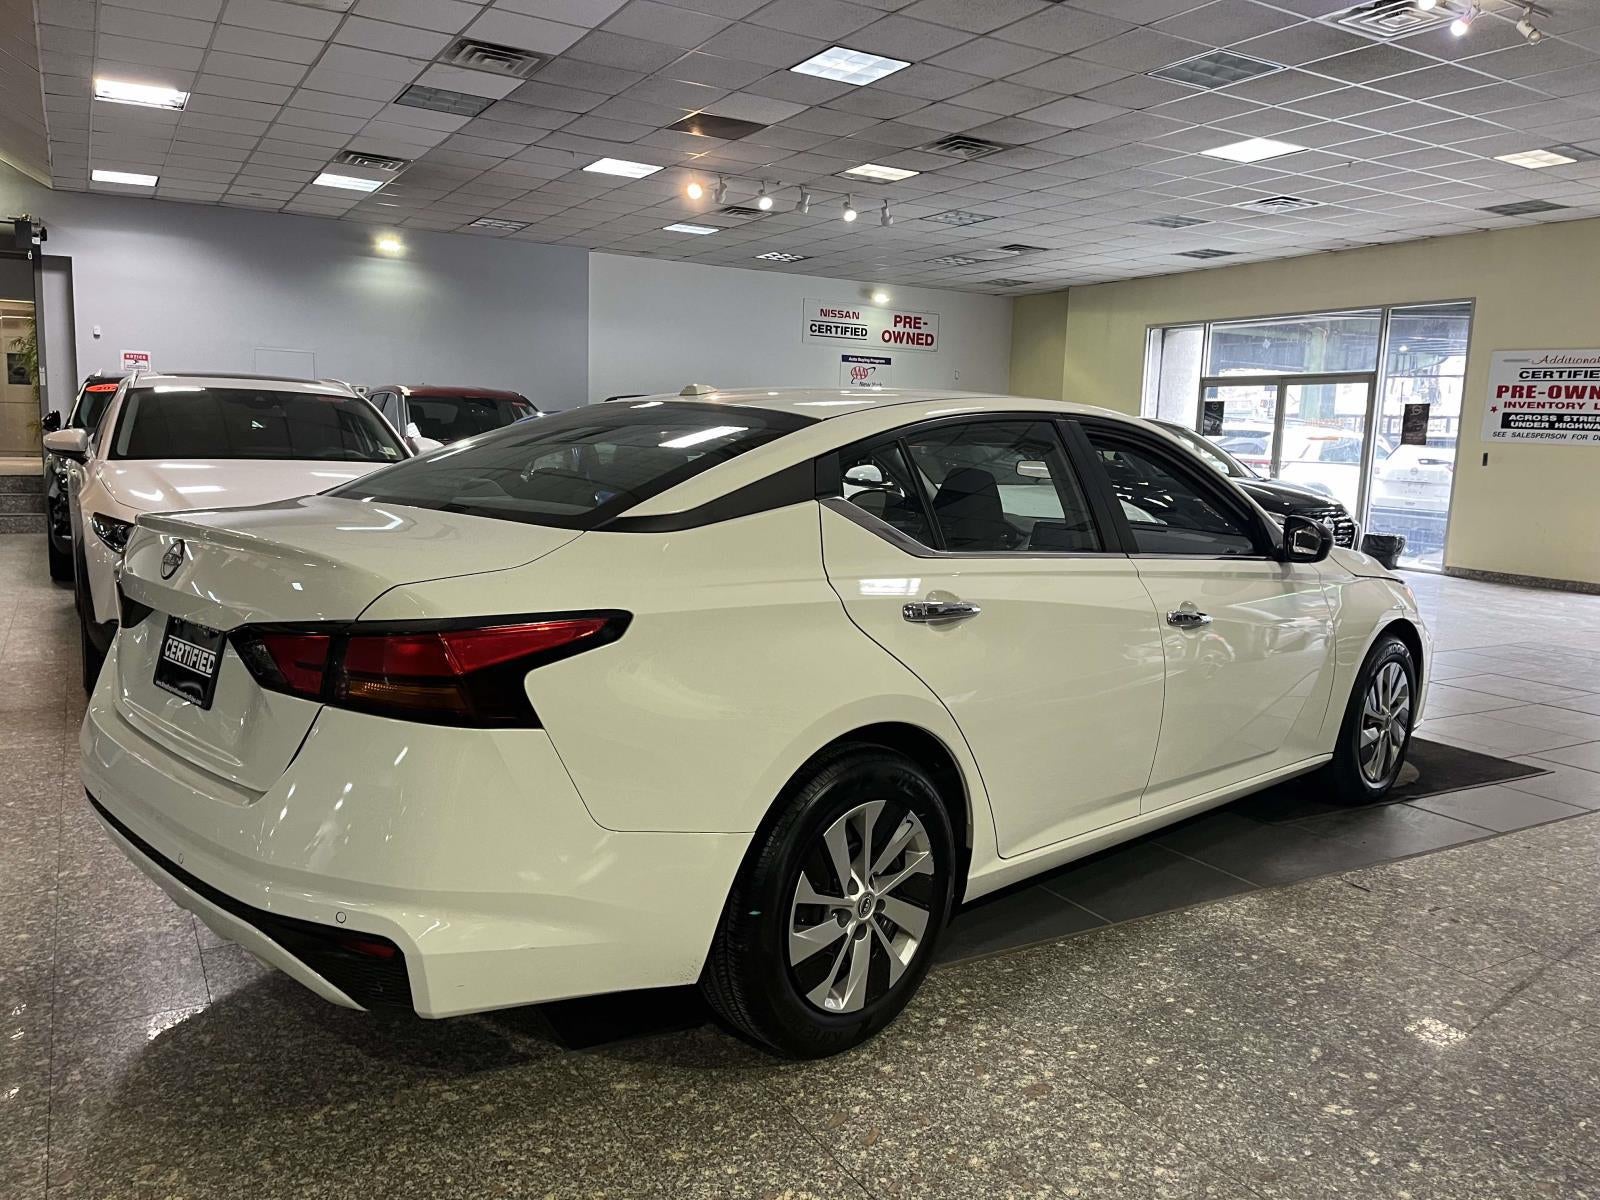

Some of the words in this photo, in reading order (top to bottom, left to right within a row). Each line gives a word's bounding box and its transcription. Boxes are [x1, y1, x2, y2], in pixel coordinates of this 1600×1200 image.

[820, 308, 860, 320] NISSAN
[893, 314, 928, 330] PRE-
[810, 323, 868, 337] CERTIFIED
[881, 330, 935, 347] OWNED
[1519, 370, 1600, 379] CERTIFIE
[1503, 401, 1586, 410] INVENTORY
[1508, 414, 1557, 422] ACROSS
[1511, 431, 1567, 440] SALESPERSON
[1571, 433, 1588, 441] FOR
[165, 638, 216, 674] CERTIFIED
